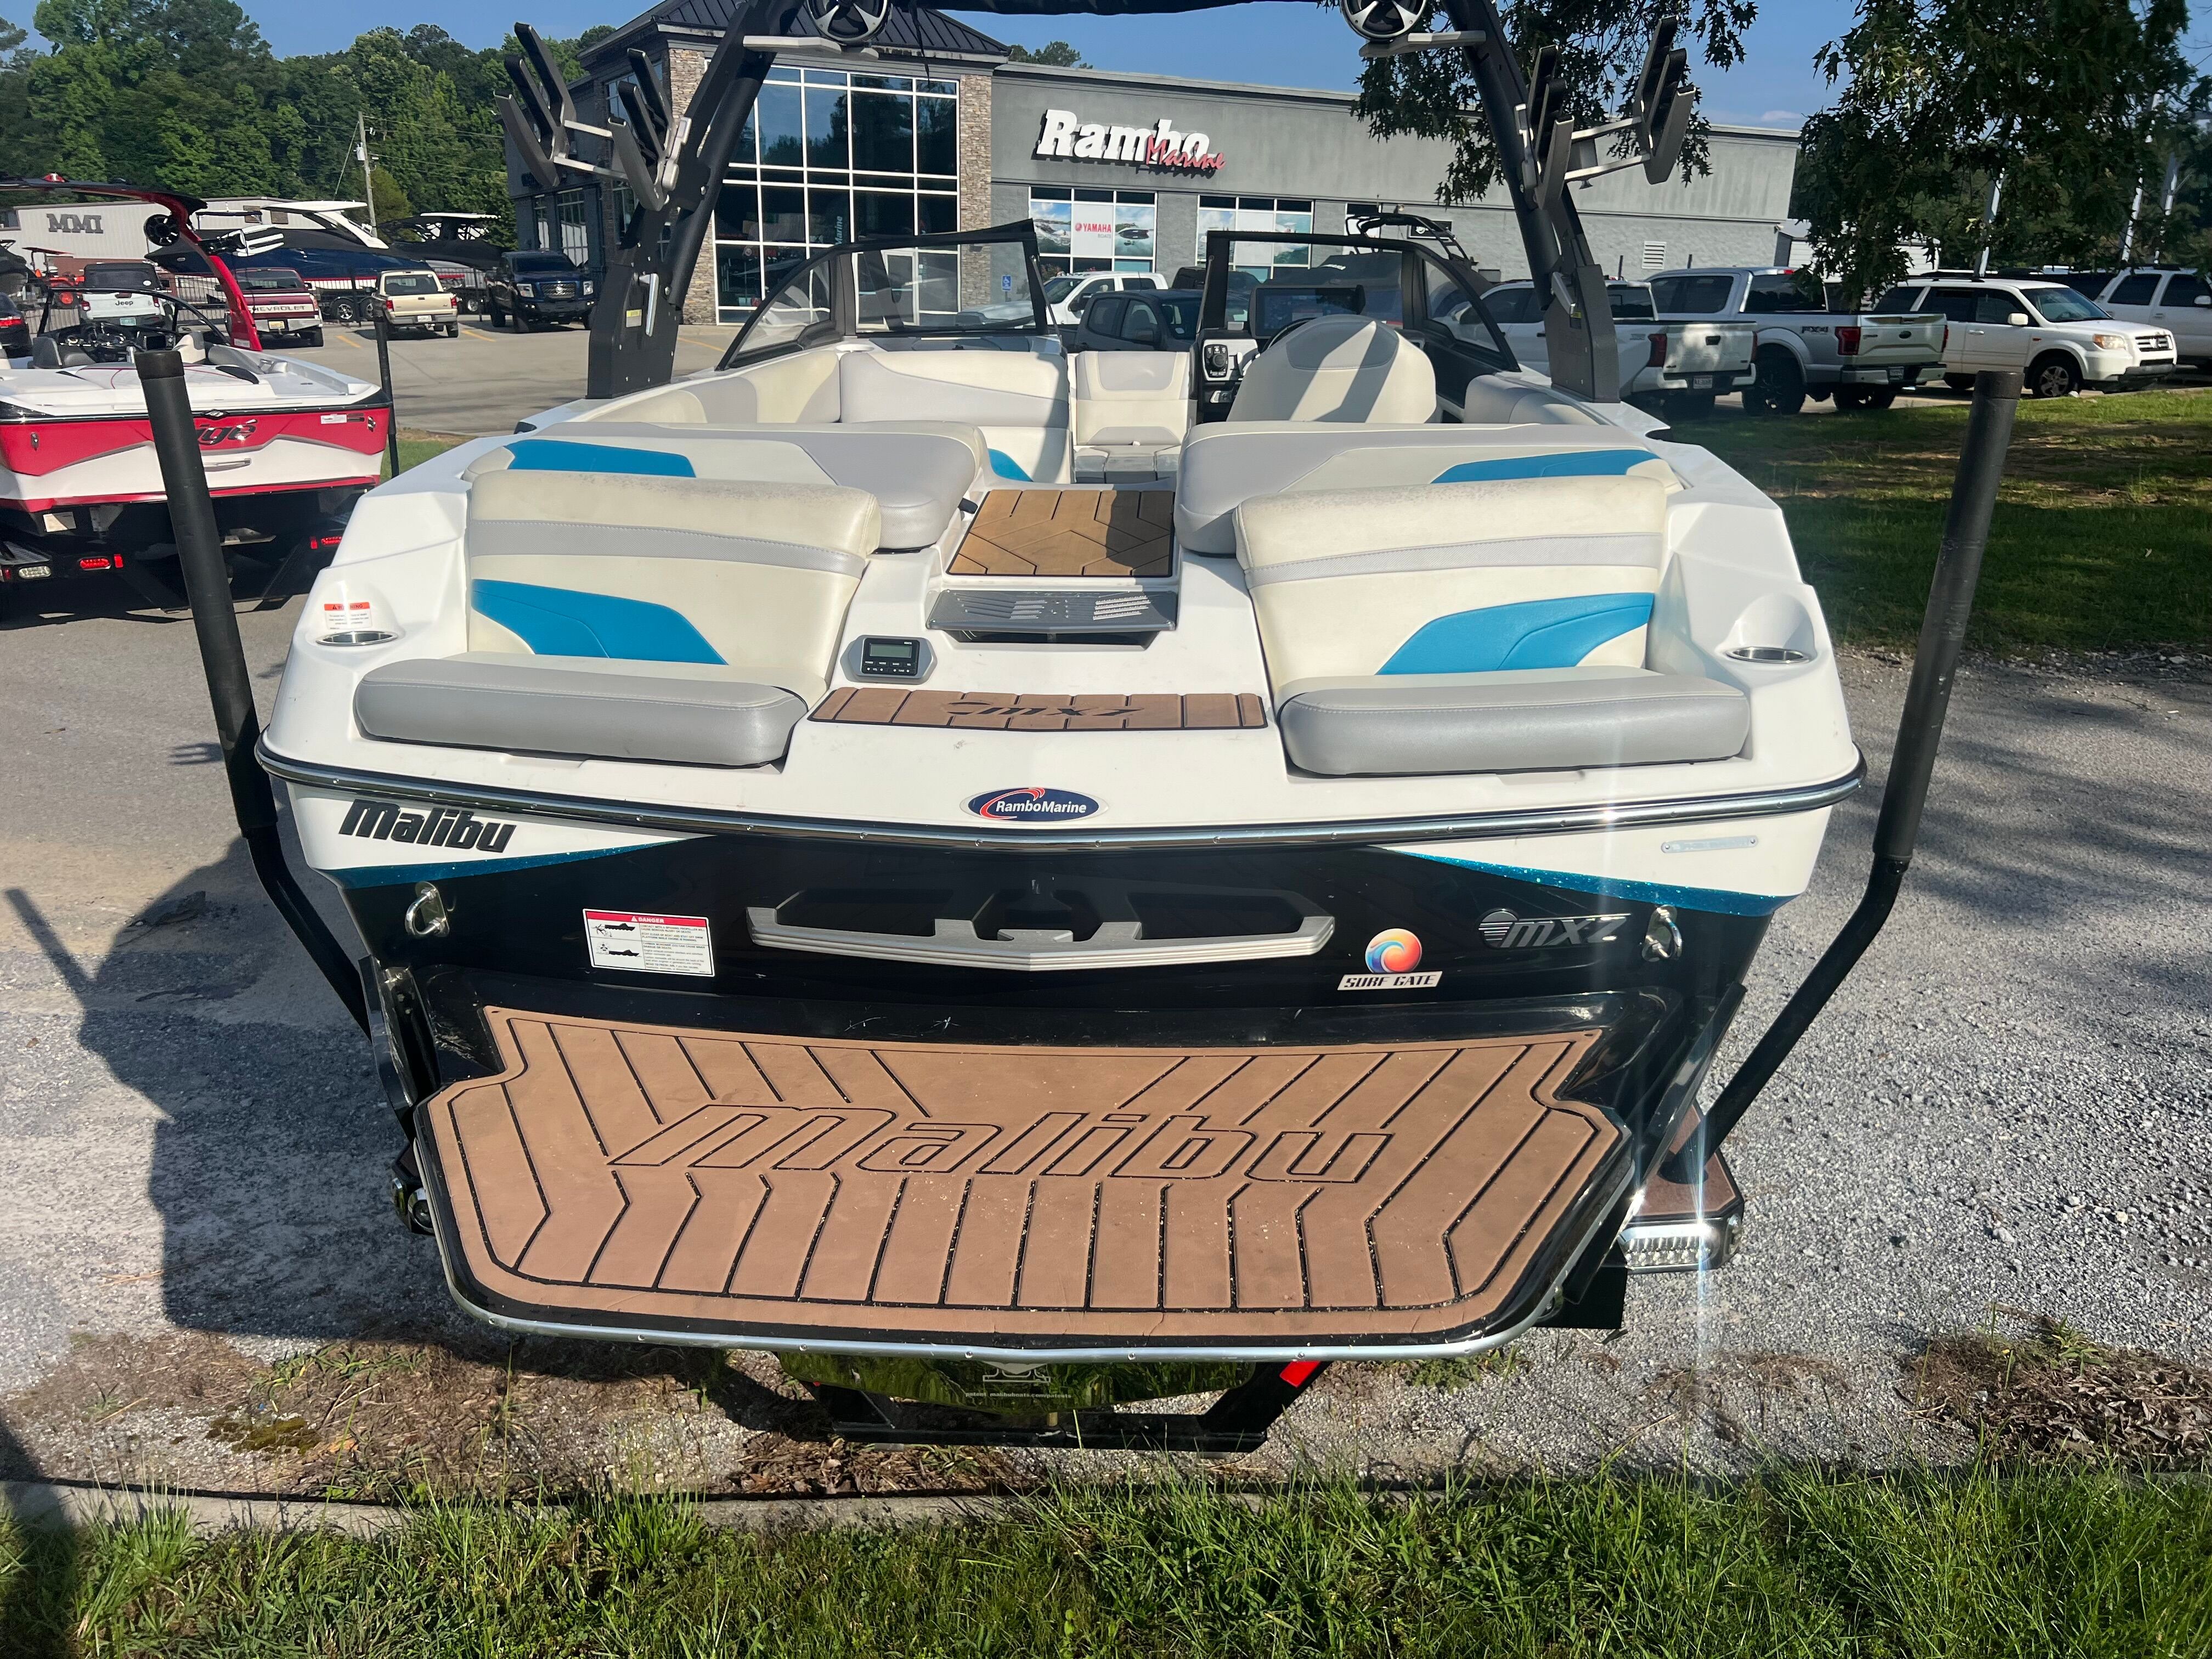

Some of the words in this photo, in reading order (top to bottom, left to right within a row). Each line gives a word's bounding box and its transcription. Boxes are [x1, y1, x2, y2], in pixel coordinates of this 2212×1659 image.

[1036, 109, 1210, 166] Rambo
[1146, 134, 1226, 170] Marine
[47, 213, 104, 233] MMI
[1083, 223, 1111, 233] YAMAHA
[1344, 977, 1390, 988] SURF
[1393, 975, 1437, 986] GATE
